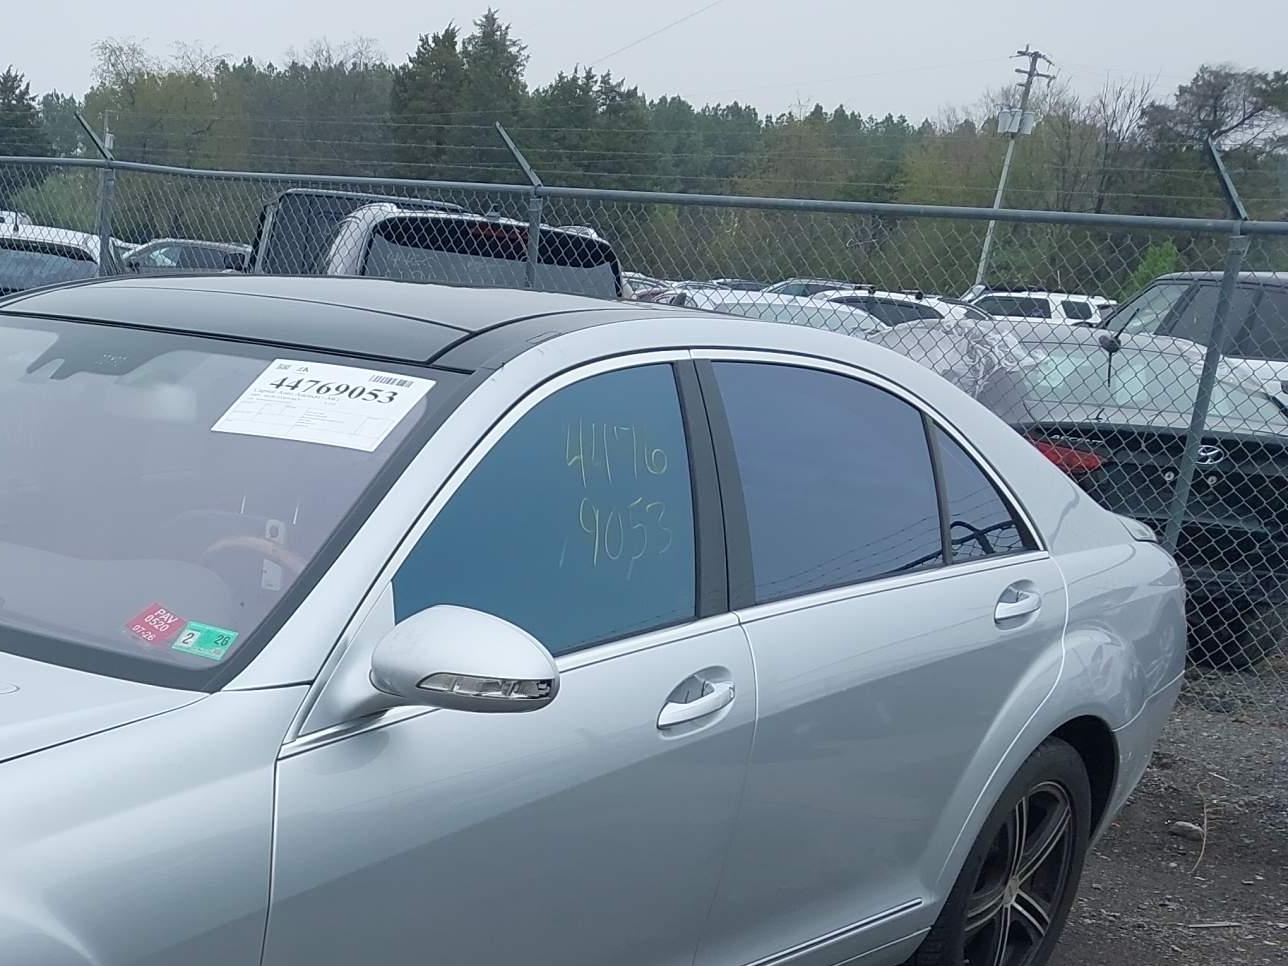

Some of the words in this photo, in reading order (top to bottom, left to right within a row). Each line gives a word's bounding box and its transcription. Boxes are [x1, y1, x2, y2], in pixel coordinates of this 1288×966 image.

[269, 376, 399, 404] 44769053
[579, 497, 673, 568] 9053
[144, 614, 170, 632] 0520
[154, 608, 179, 624] PAV
[132, 624, 157, 641] 07-26
[182, 632, 195, 645] 2
[214, 634, 231, 647] 26
